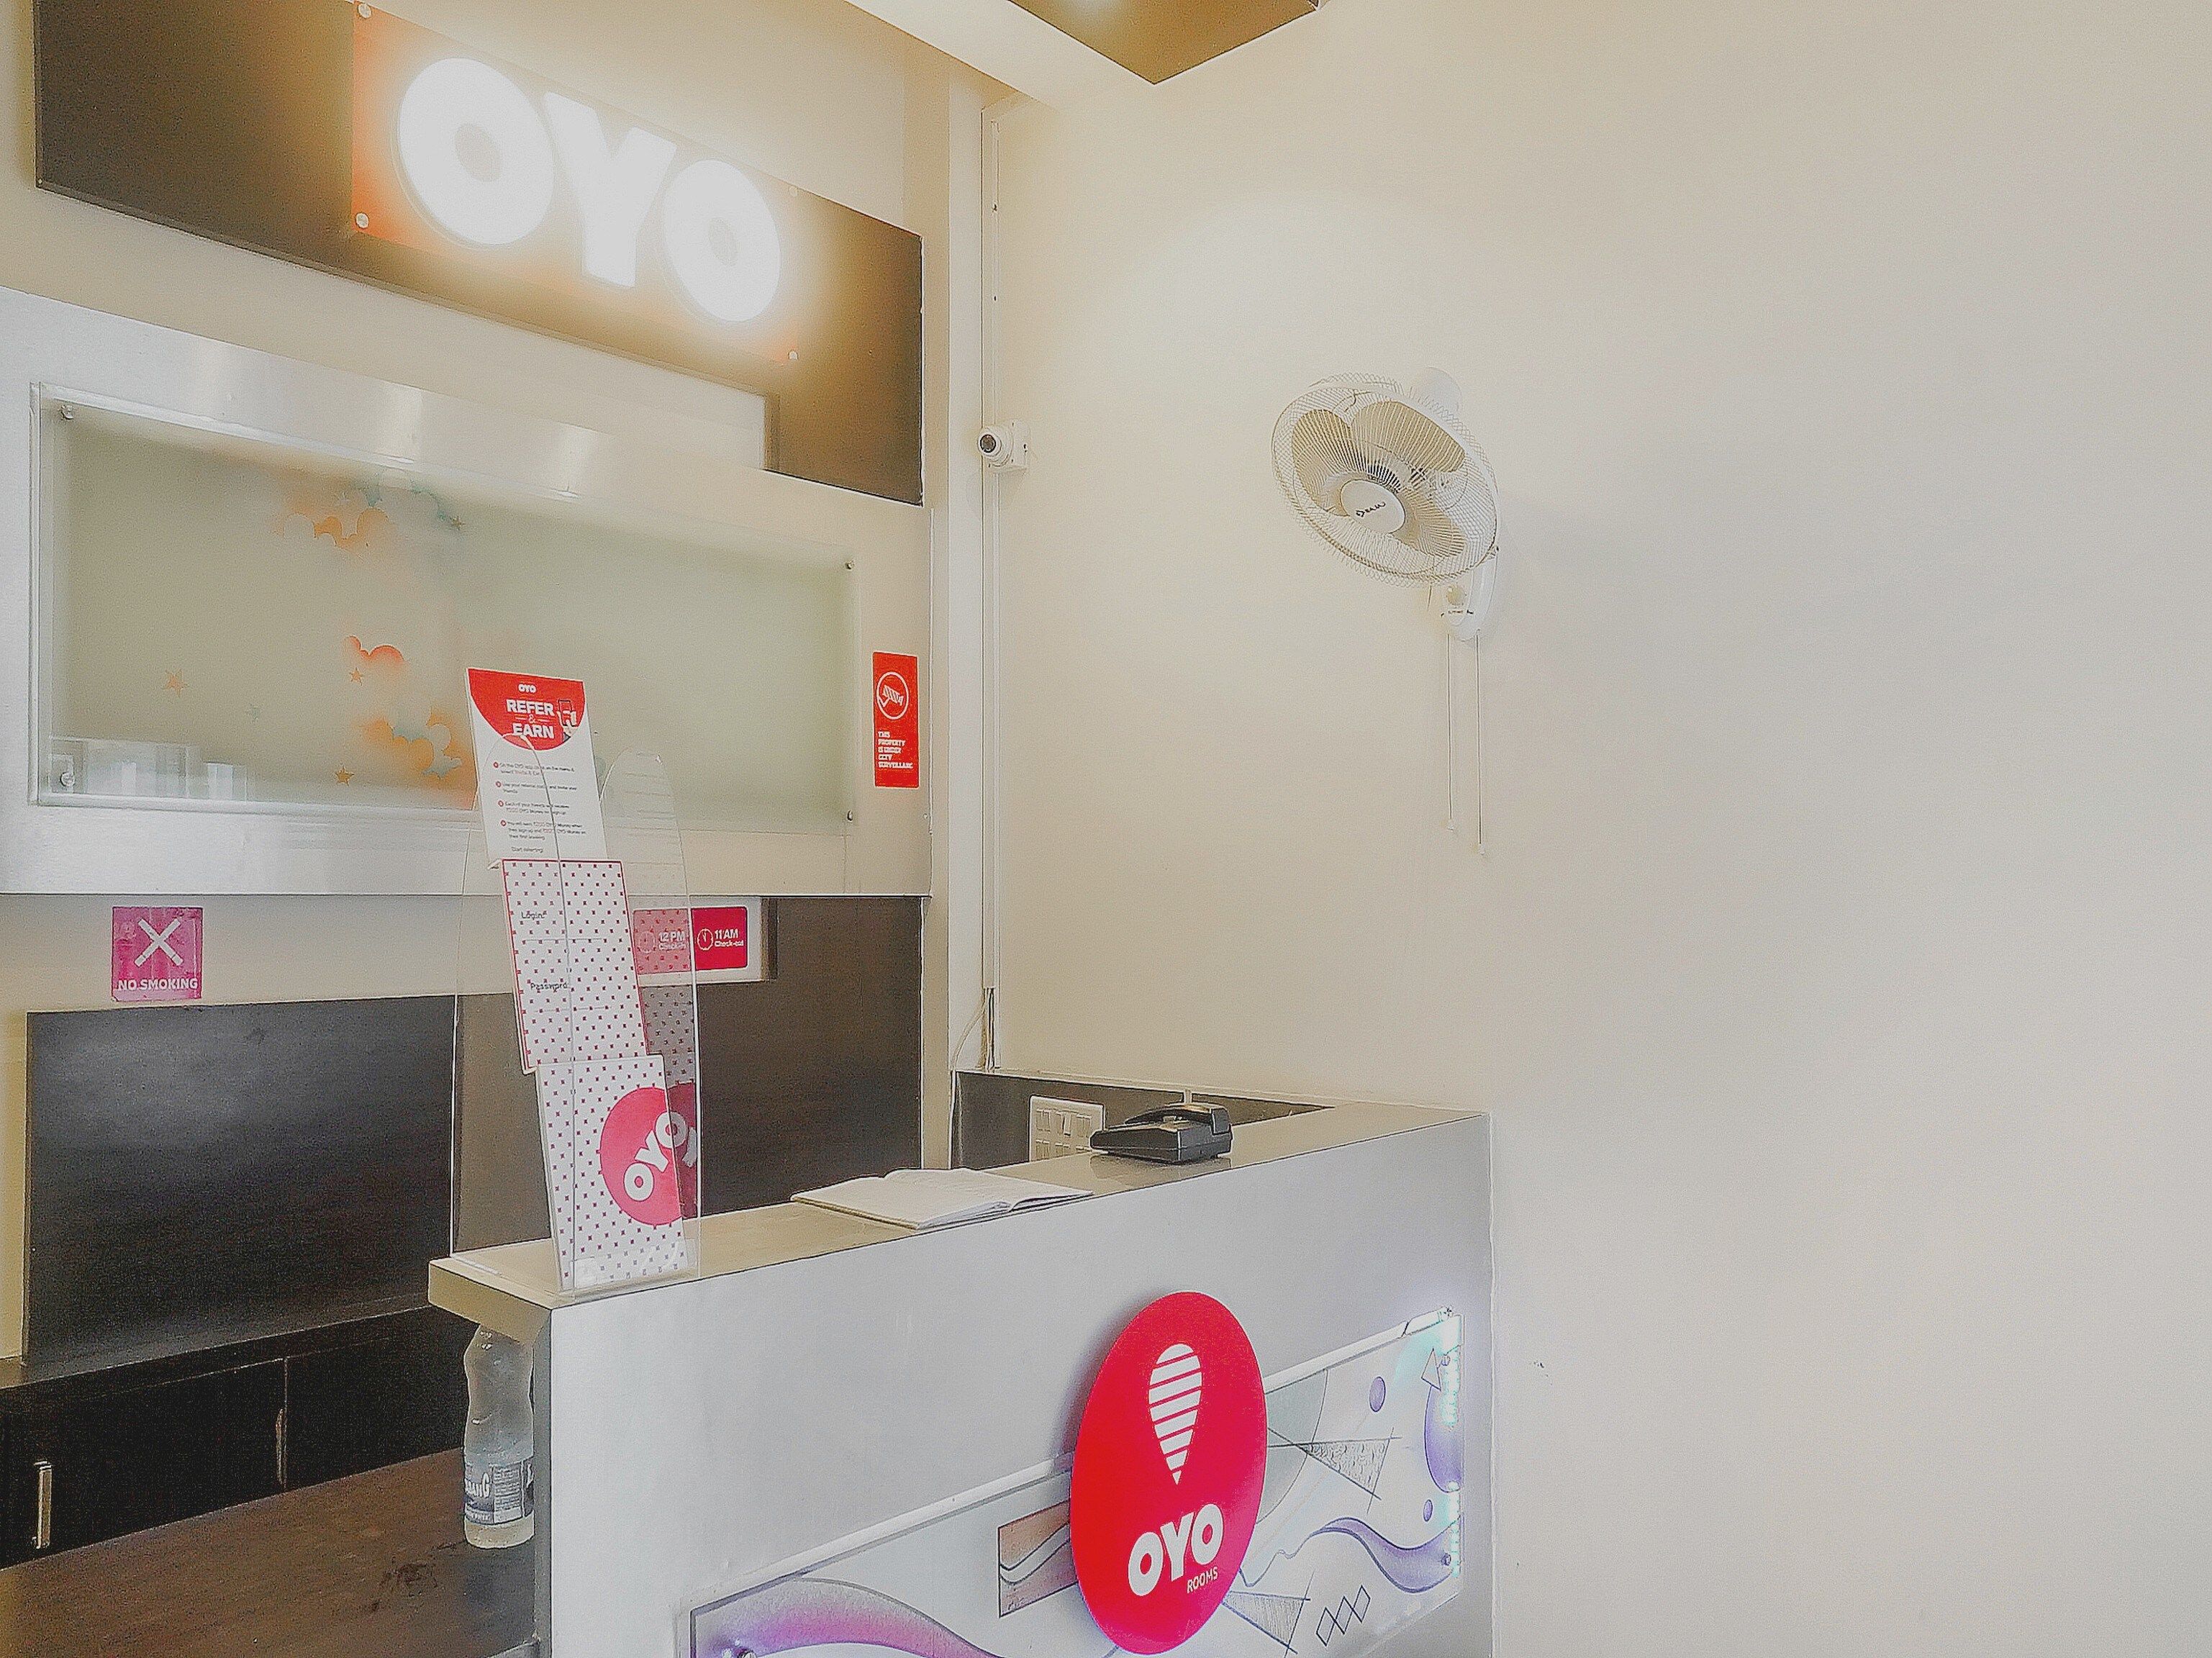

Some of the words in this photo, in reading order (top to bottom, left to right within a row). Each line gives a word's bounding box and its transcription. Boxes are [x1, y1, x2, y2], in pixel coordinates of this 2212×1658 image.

[397, 57, 782, 323] OYO
[518, 683, 537, 694] OYO
[506, 699, 556, 717] REFER
[528, 714, 536, 724] &
[512, 722, 555, 740] EARN
[715, 929, 722, 940] 11
[722, 928, 739, 940] AM
[117, 979, 137, 991] NO
[140, 977, 199, 991] SMOKING
[623, 1110, 689, 1202] OYO
[1128, 1503, 1224, 1597] OYO
[1187, 1566, 1218, 1595] ROOMS
